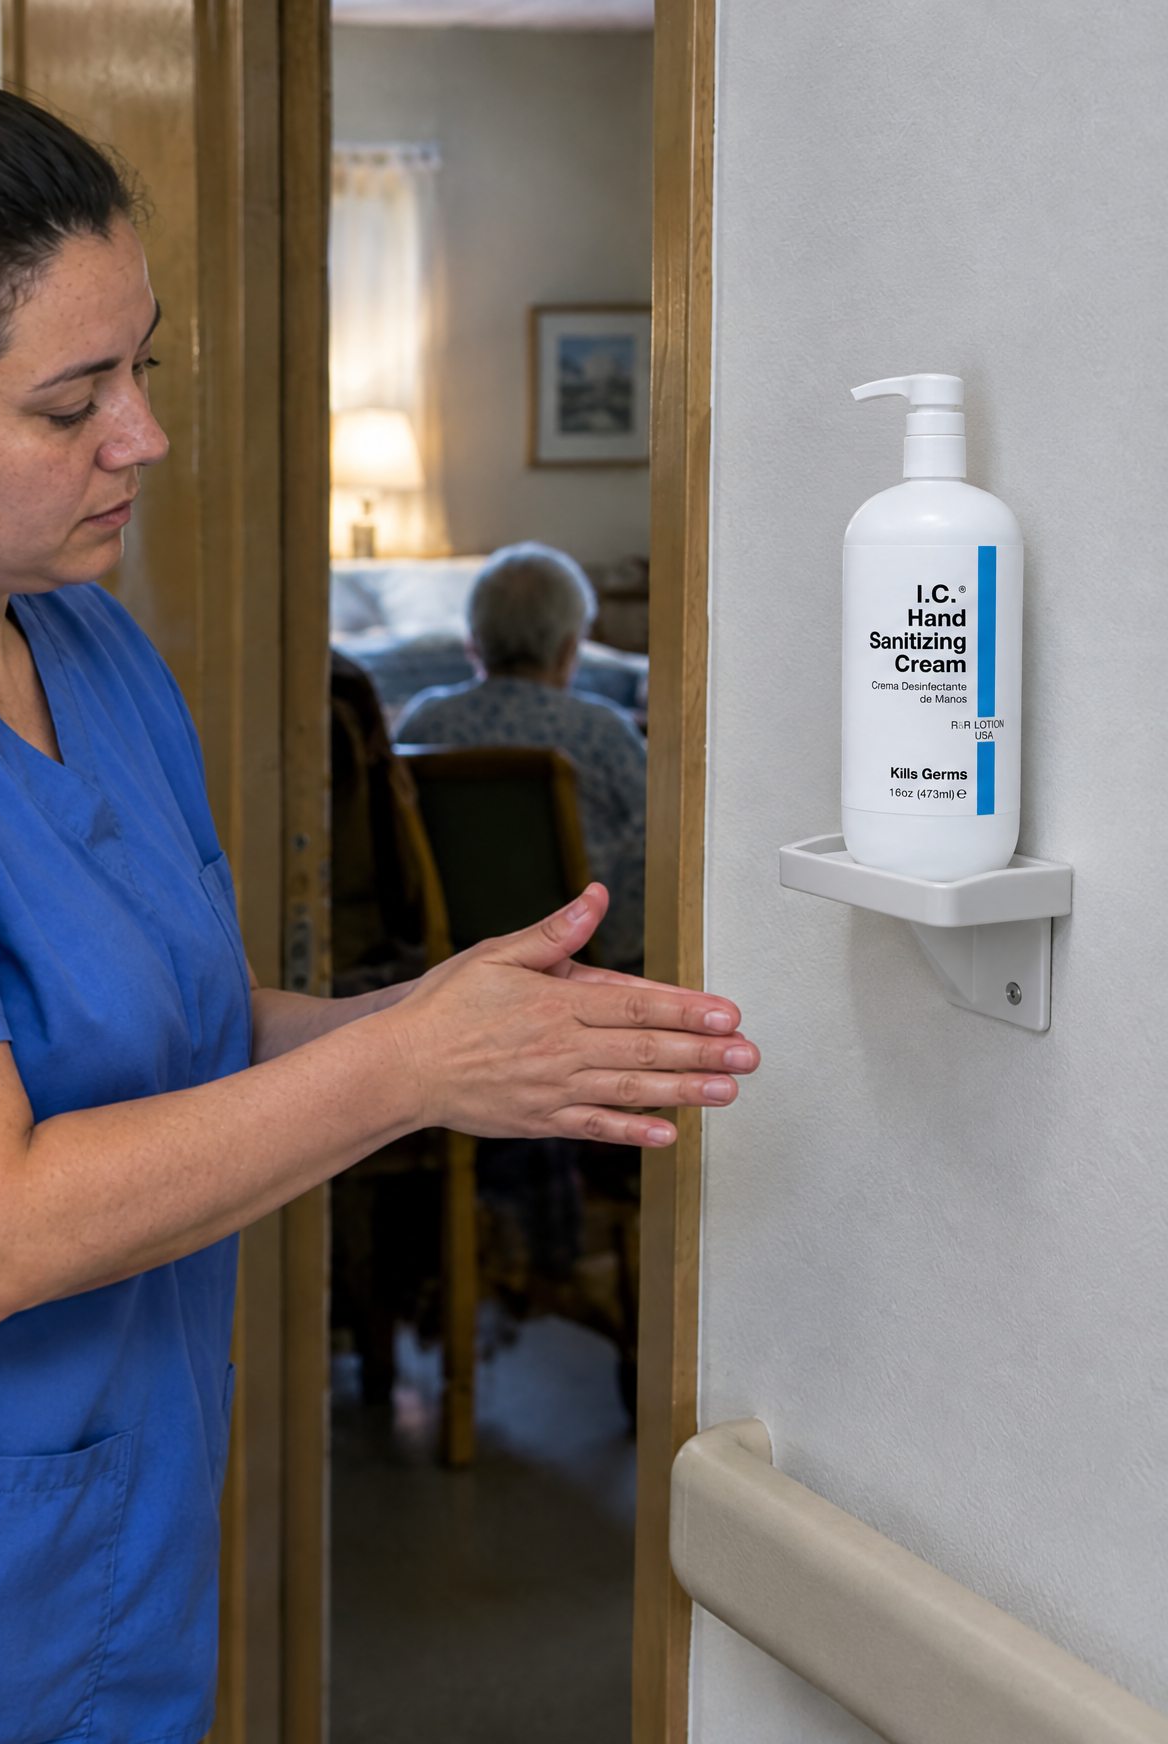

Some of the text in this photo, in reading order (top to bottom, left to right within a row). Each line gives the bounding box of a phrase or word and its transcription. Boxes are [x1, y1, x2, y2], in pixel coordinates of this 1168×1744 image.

[907, 608, 967, 628] Hand
[869, 631, 967, 655] Sanitizing
[894, 654, 967, 673] Cream
[871, 680, 968, 692] Crema Desinfectante
[919, 694, 968, 704] de Manos
[974, 719, 1005, 730] LOTION
[974, 730, 994, 740] USA
[890, 766, 968, 780] Kills Germs
[889, 788, 914, 799] 16oz
[916, 788, 955, 801] (473ml)
